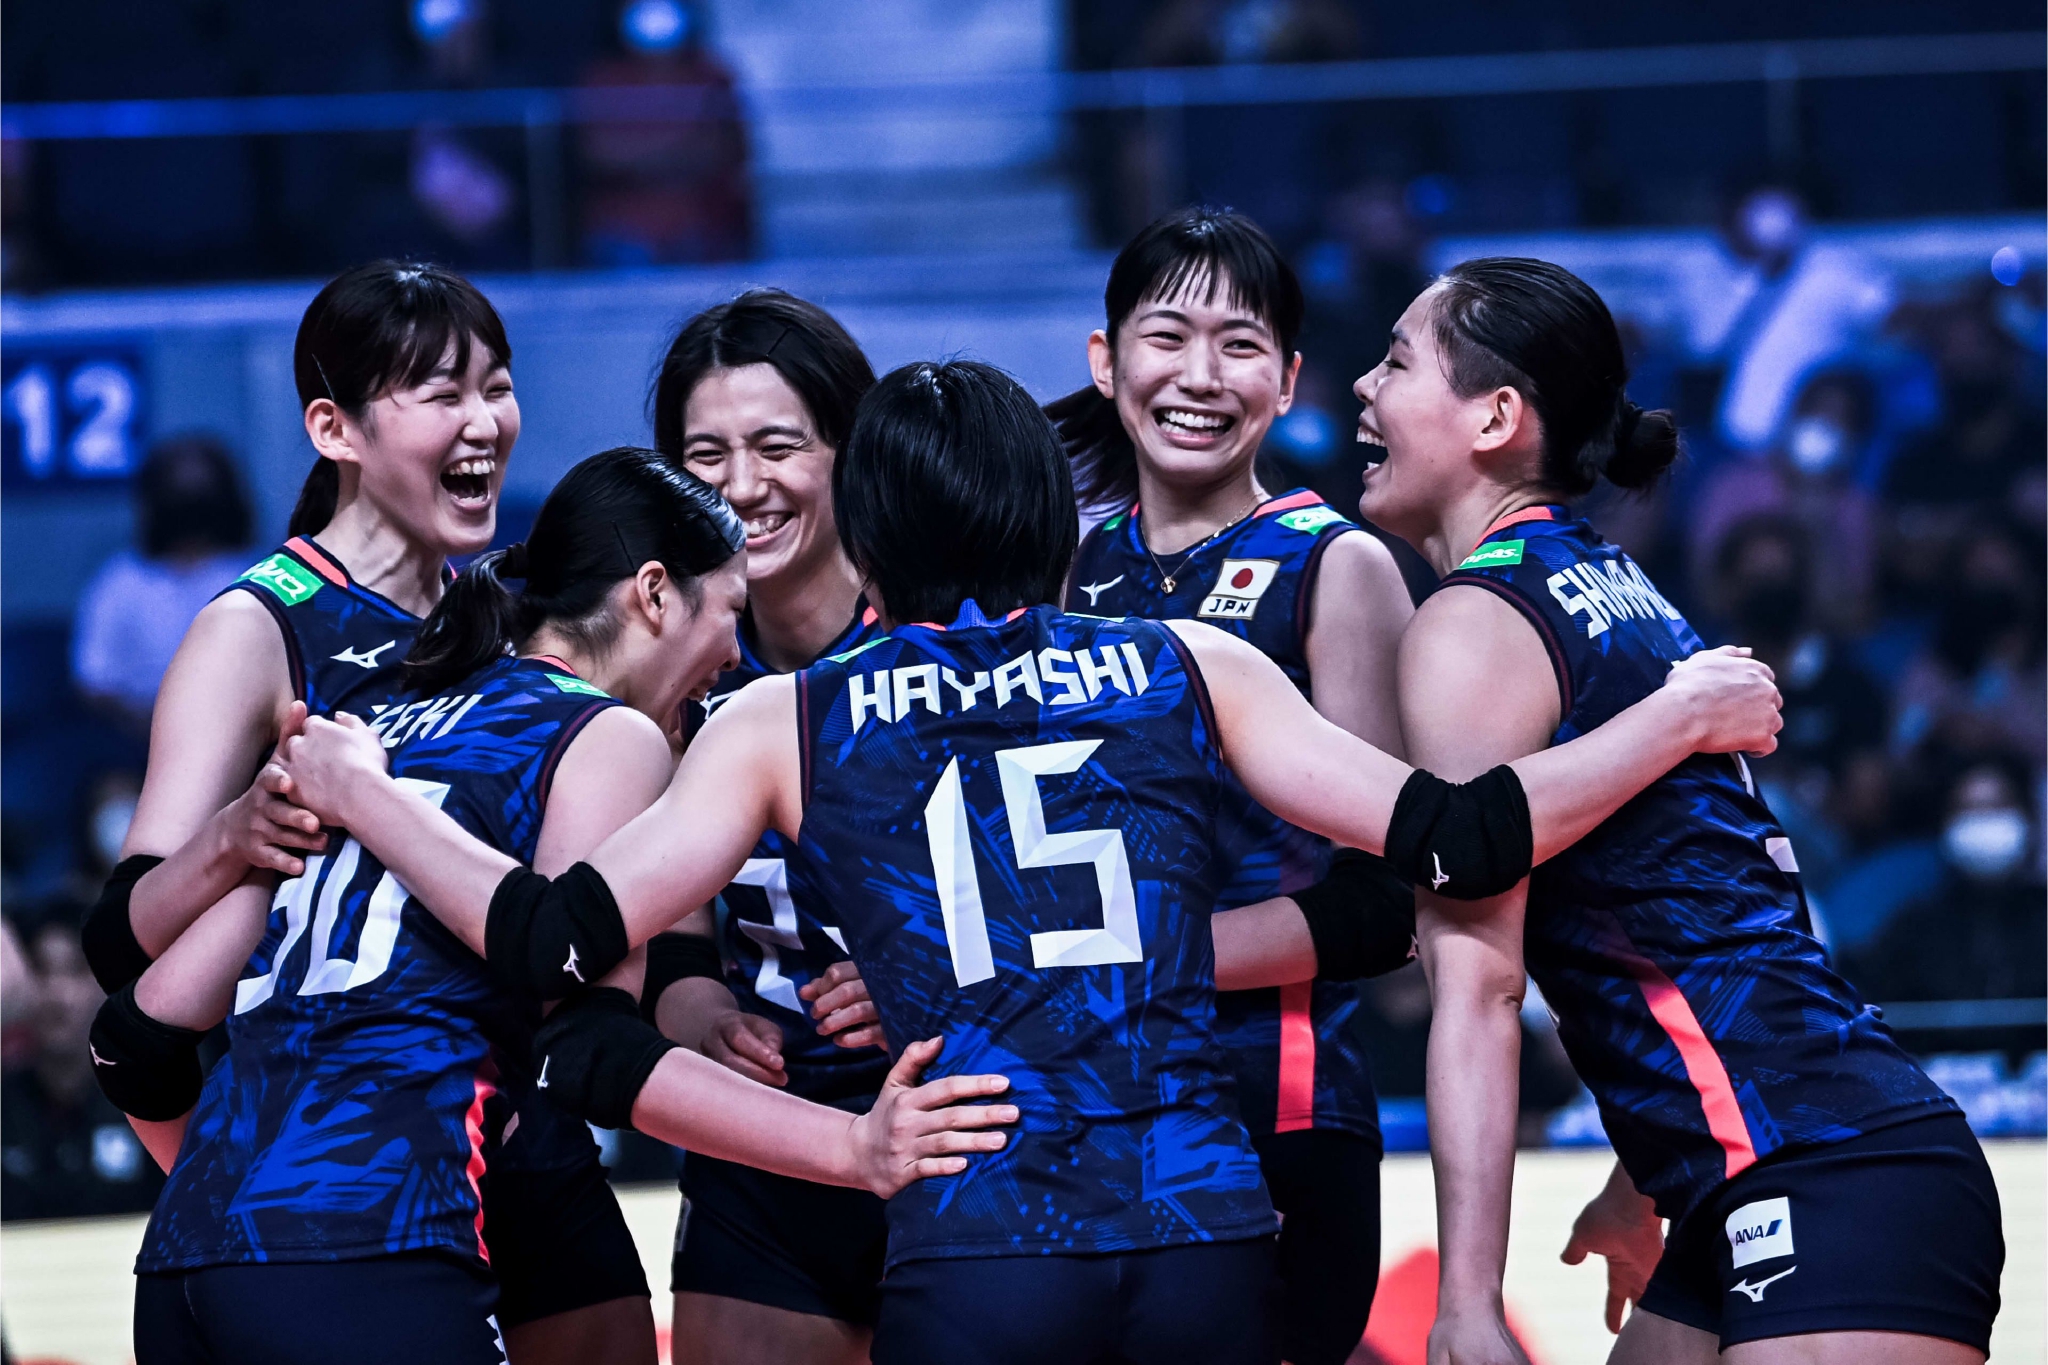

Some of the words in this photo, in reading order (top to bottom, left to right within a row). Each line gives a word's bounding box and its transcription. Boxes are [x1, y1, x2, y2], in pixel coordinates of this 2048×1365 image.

[5, 364, 132, 474] 12
[1208, 598, 1251, 614] JPN
[848, 642, 1150, 735] HAYASHI
[924, 738, 1144, 988] 15
[1735, 1224, 1764, 1247] ANA
